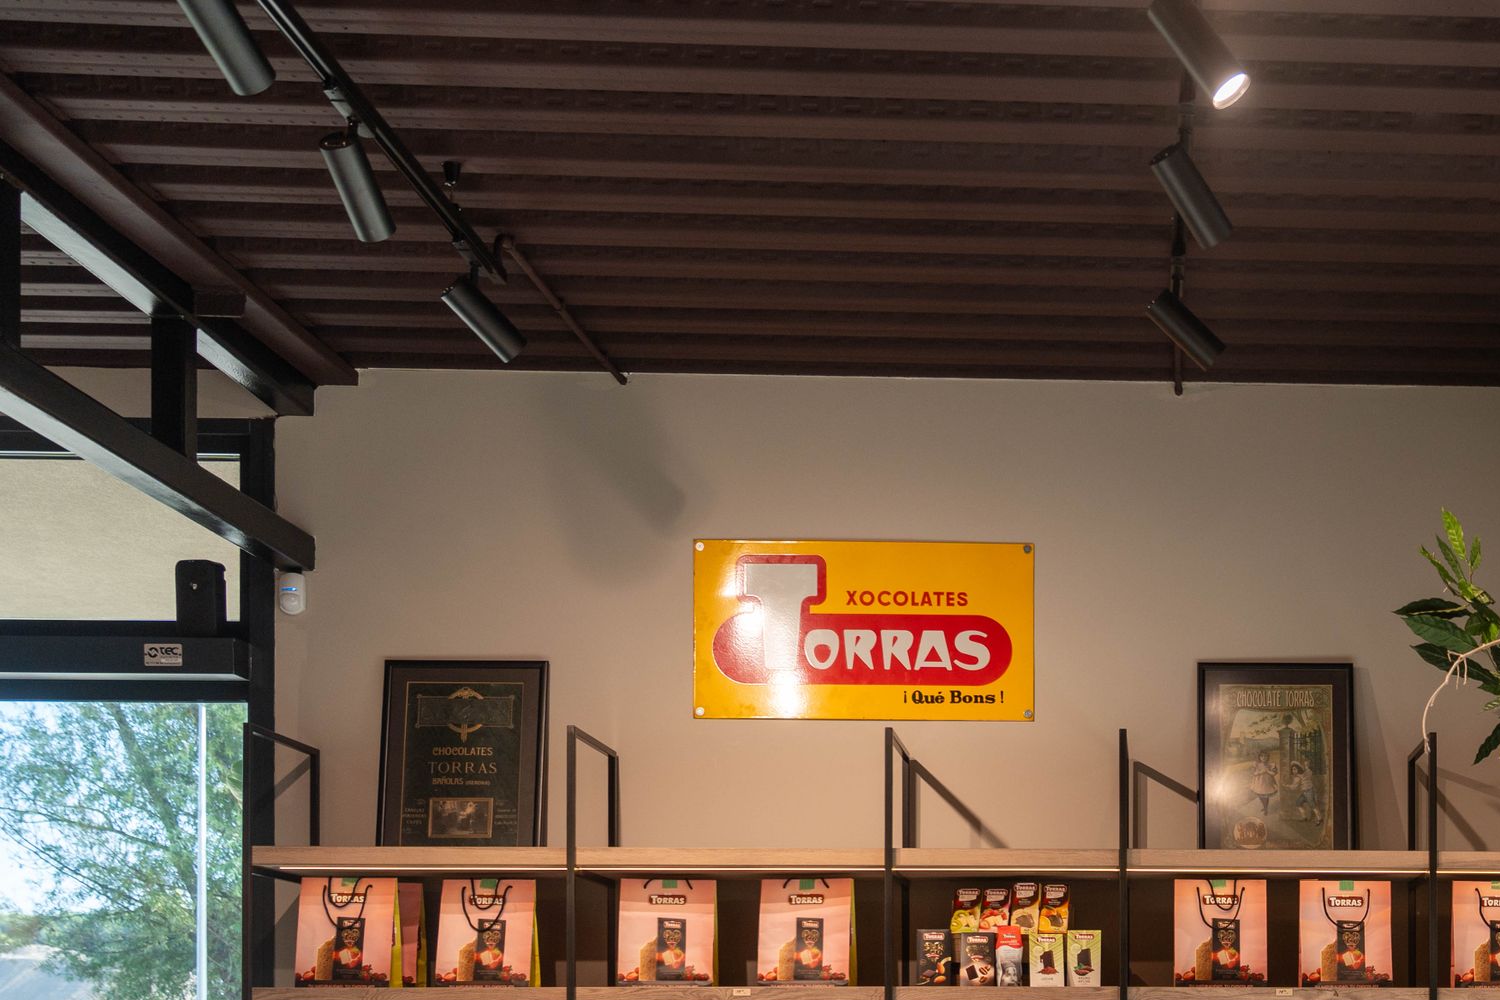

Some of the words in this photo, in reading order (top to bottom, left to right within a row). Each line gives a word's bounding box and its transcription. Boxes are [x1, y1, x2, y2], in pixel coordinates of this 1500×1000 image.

[846, 590, 969, 607] XOCOLATES
[744, 562, 991, 671] TORRAS
[1236, 691, 1281, 707] CHOCOLATE
[432, 746, 493, 756] CHOCOLATES
[428, 761, 497, 774] TORRAS
[651, 896, 685, 905] TORRAS
[791, 895, 823, 905] TORRAS
[1329, 897, 1362, 907] TORRAS
